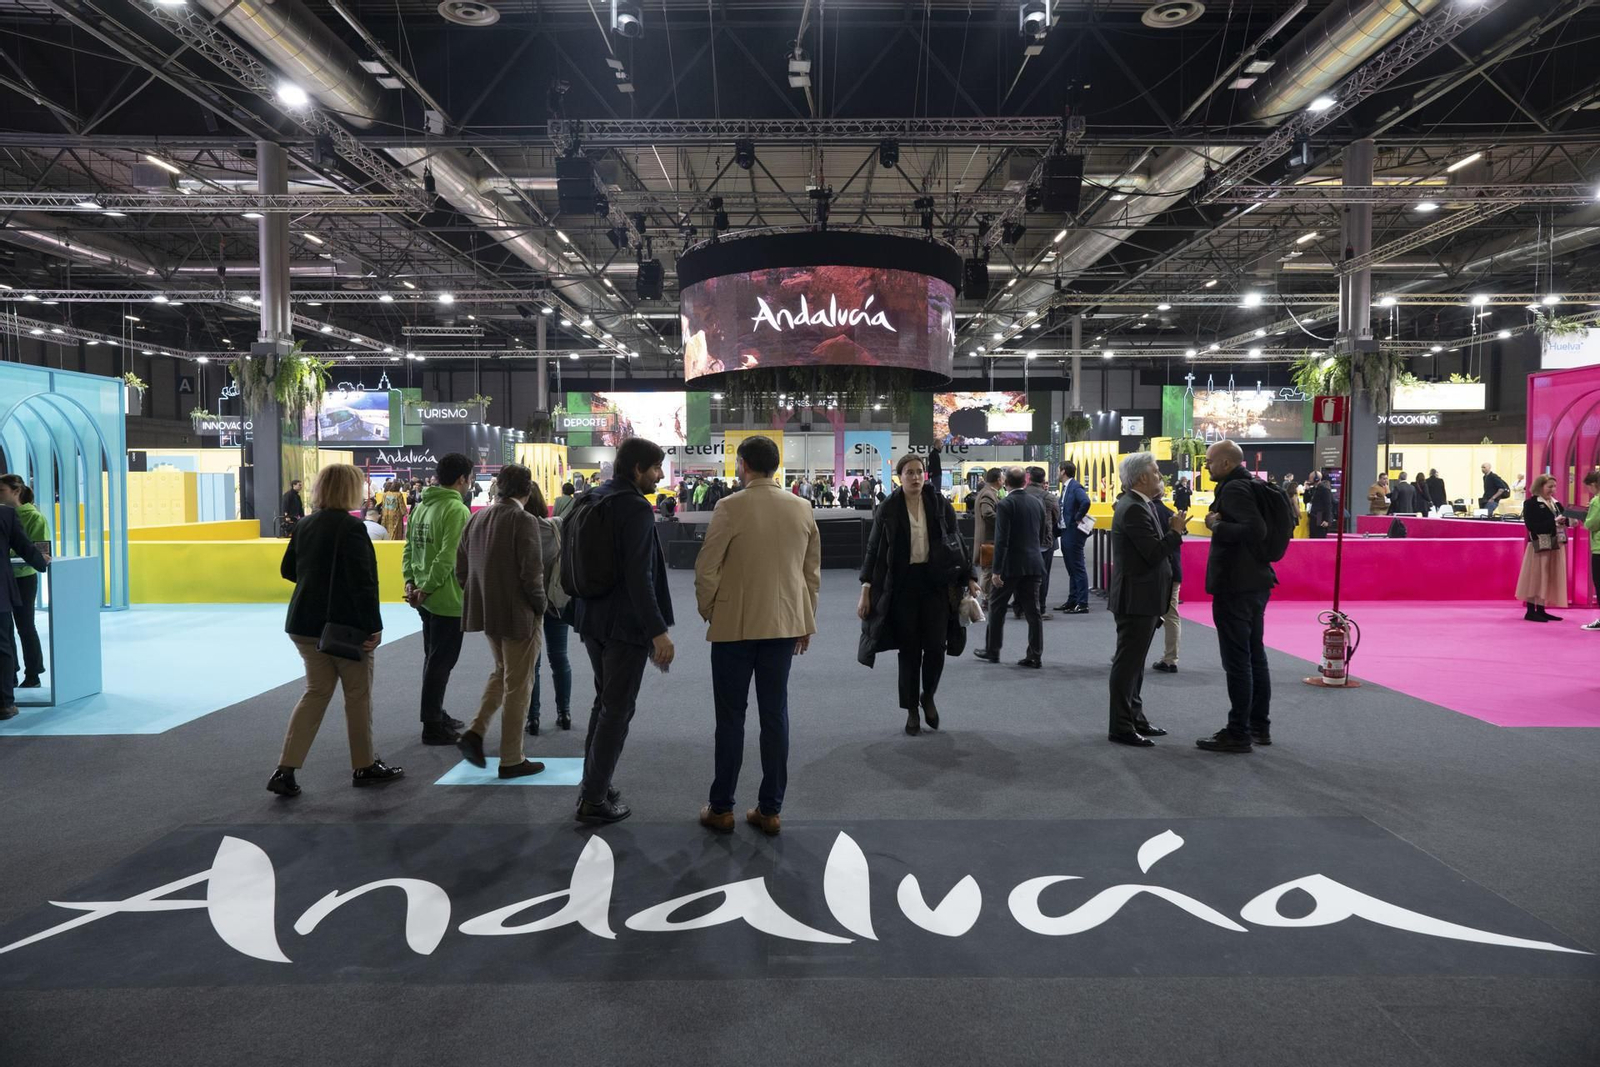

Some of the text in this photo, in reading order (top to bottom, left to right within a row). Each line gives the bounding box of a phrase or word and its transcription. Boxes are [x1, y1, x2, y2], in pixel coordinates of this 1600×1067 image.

[752, 294, 895, 331] Andalucía
[179, 379, 191, 391] A
[418, 408, 468, 419] TURISMO
[563, 417, 608, 428] DEPORTE
[908, 443, 969, 454] serice
[376, 448, 439, 465] Andalucía
[0, 829, 1591, 962] Andalucía
